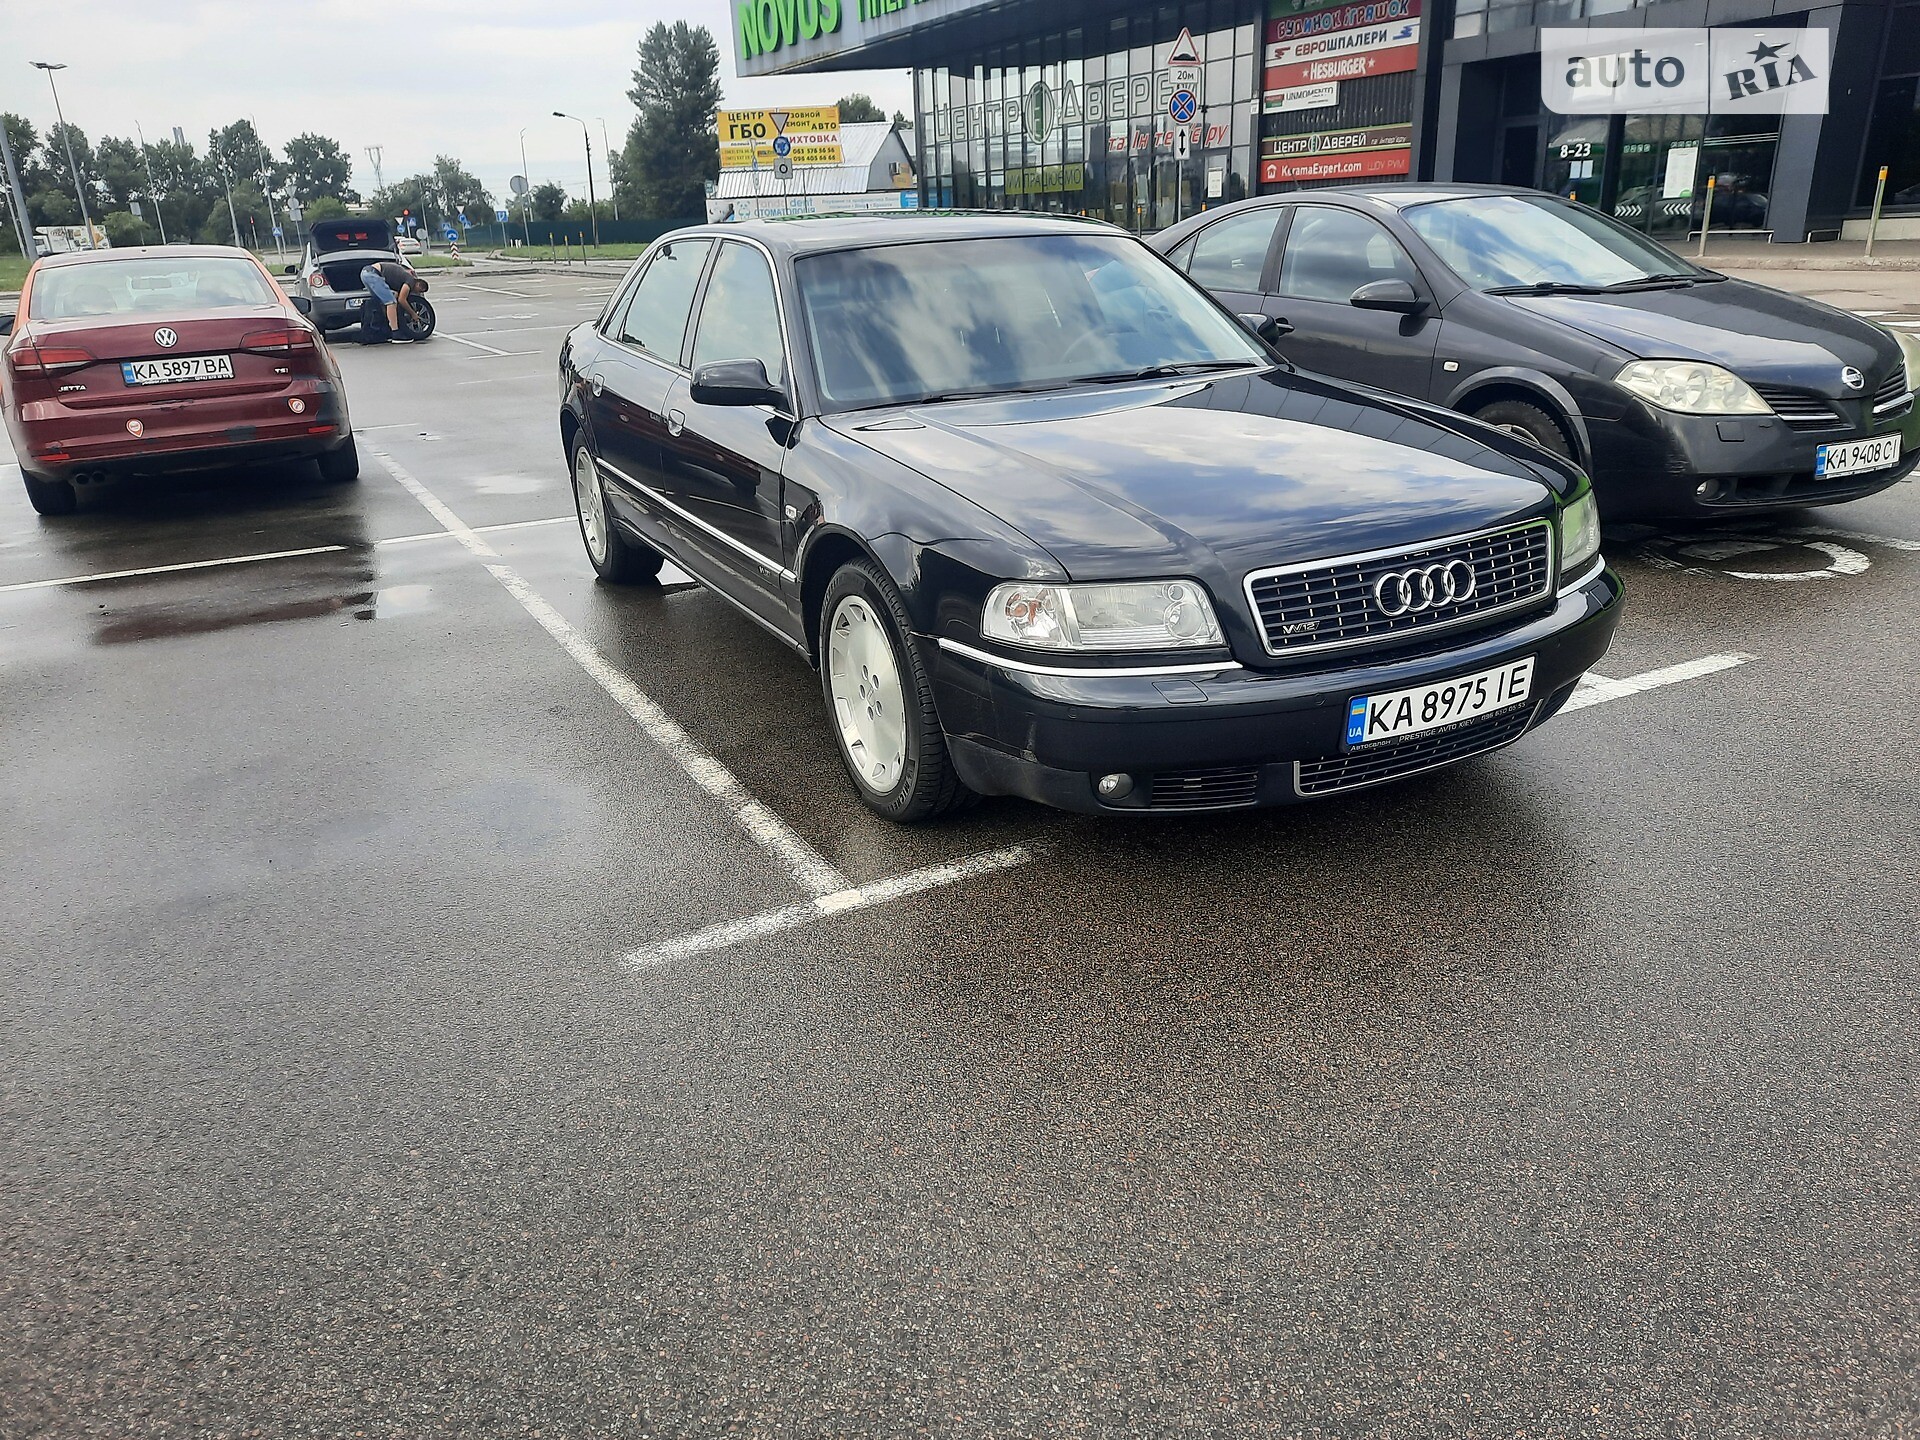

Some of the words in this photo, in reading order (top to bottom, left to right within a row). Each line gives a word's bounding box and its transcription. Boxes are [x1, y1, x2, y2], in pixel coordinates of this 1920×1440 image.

[738, 0, 840, 59] NOVUS
[1277, 10, 1341, 39] БУДИНОК
[1295, 29, 1387, 56] ЄВРОШПАЛЕРИ
[1310, 56, 1366, 80] HESBURGER
[728, 111, 764, 122] ЦЕНТР
[936, 98, 1019, 143] ЦЕНТР
[1058, 68, 1202, 125] ДВЕРЕ
[729, 123, 766, 139] ГБО
[811, 122, 837, 130] АВТО
[788, 135, 837, 143] ИХТОВКА
[1273, 139, 1307, 153] ЦЕНТР
[1321, 132, 1367, 148] ДВЕРЕЙ
[1560, 143, 1591, 158] 8-23
[133, 364, 160, 379] KA
[163, 361, 200, 376] 5897
[204, 358, 230, 373] BA
[1826, 448, 1846, 470] KA
[1852, 443, 1881, 466] 9408
[1349, 728, 1362, 738] UA
[1368, 696, 1412, 735] KA
[1421, 677, 1488, 723] 8975
[1497, 664, 1527, 703] IE
[1399, 728, 1436, 743] PRESTIGE
[1438, 723, 1457, 734] AVTO
[1459, 718, 1475, 729] KIEV
